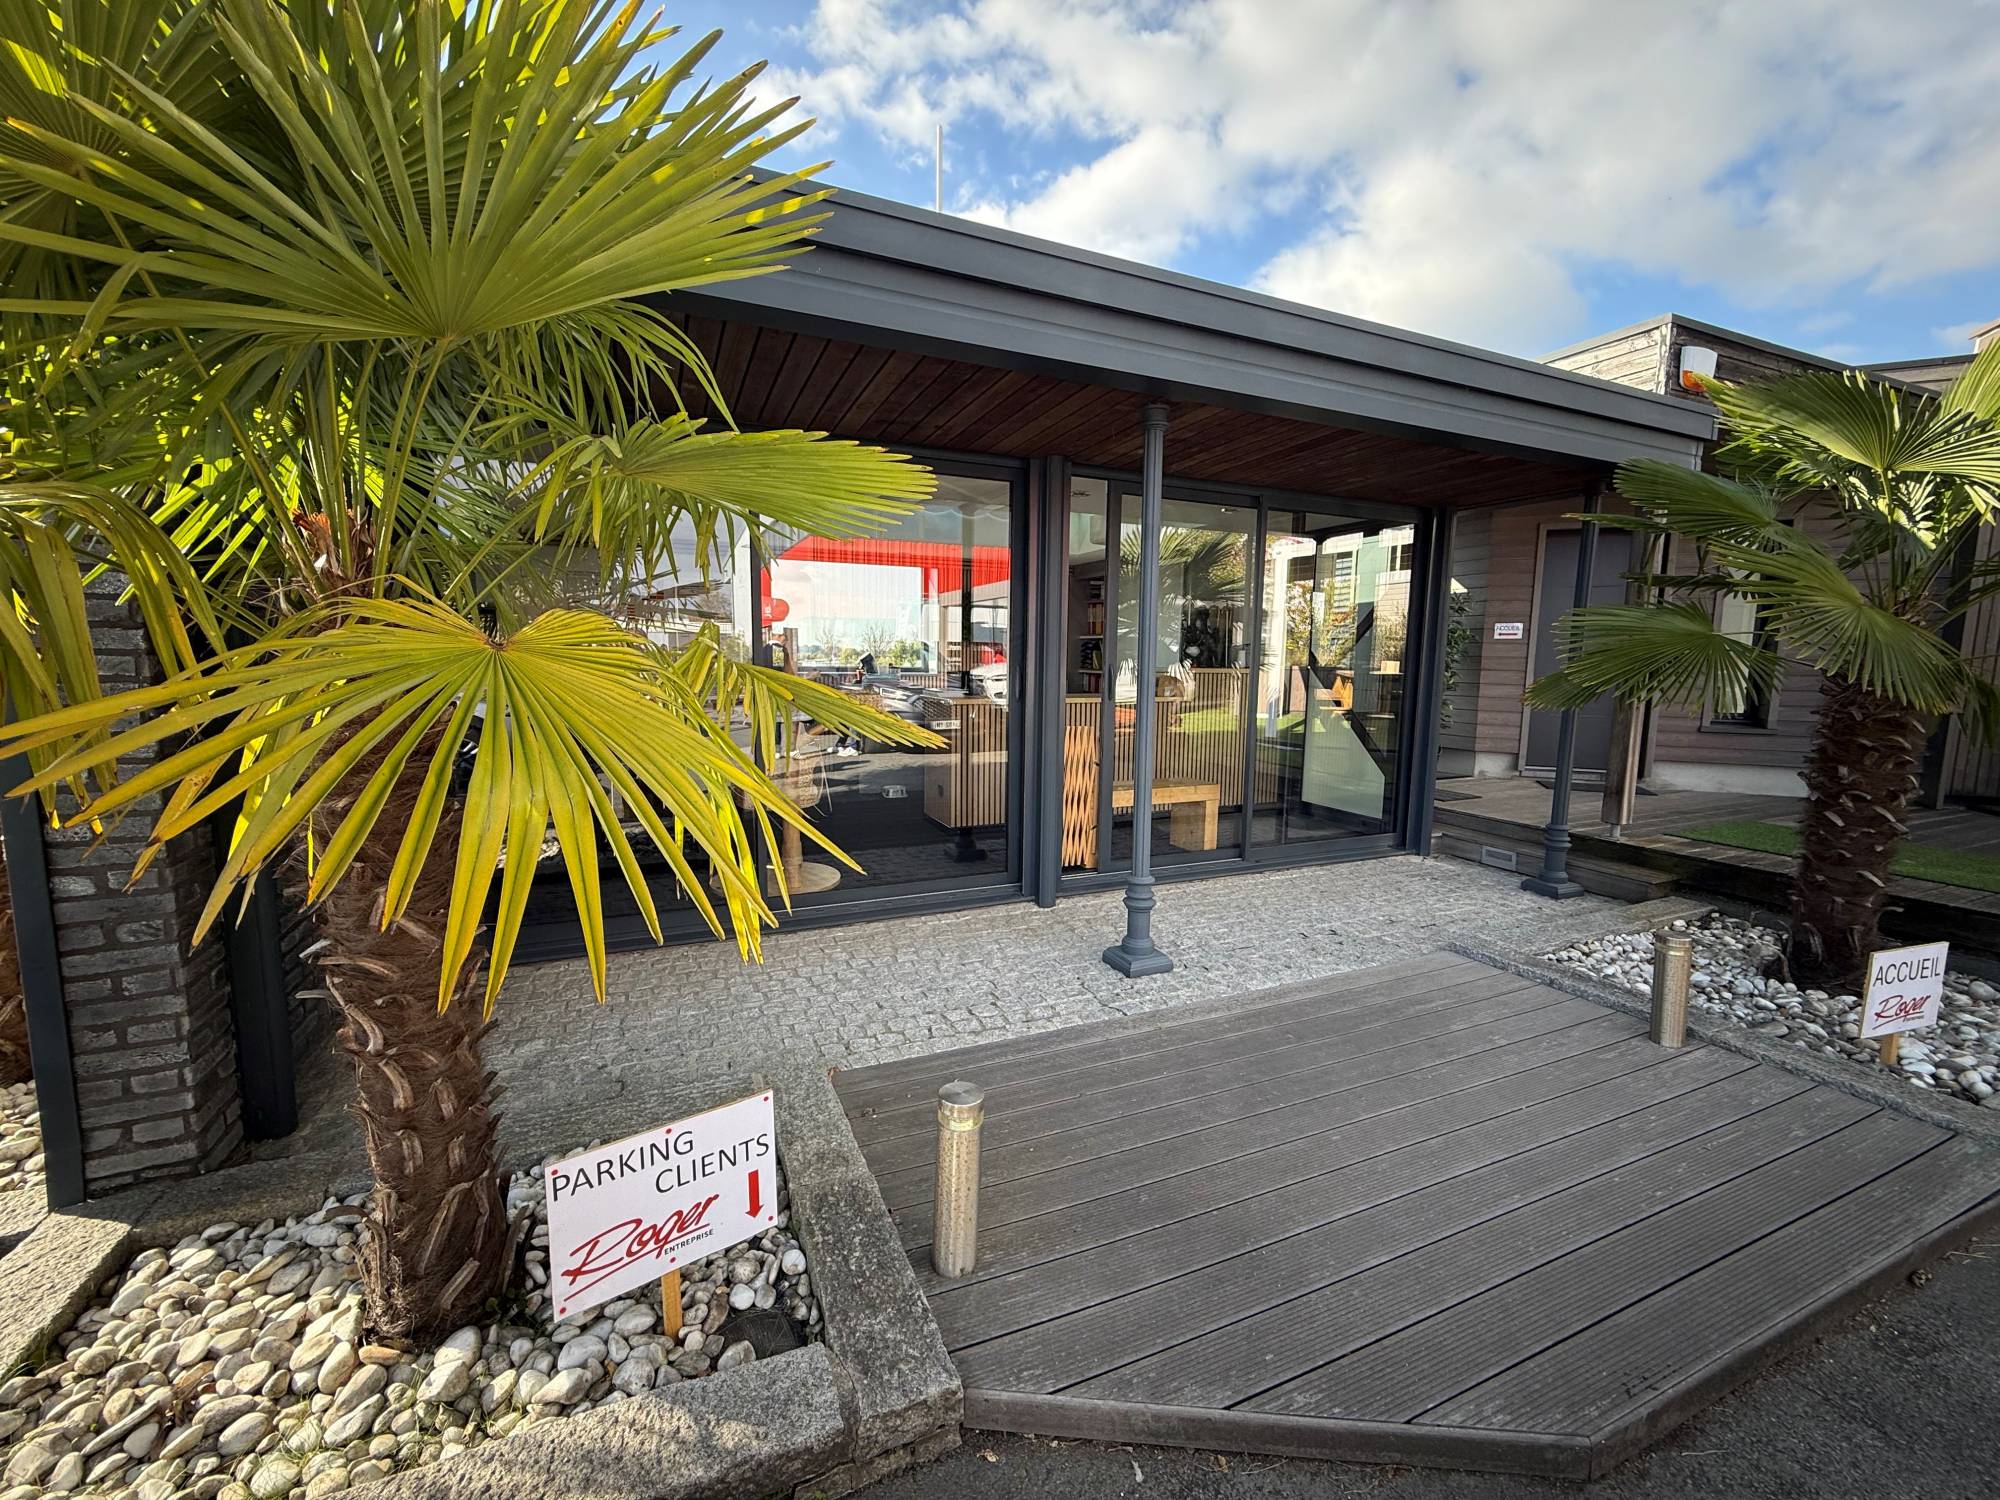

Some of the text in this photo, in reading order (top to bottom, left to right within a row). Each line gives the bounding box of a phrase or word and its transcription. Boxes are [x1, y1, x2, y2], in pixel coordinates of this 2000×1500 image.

[1872, 957, 1941, 987] ACCUEIL
[1874, 994, 1932, 1021] Roger
[551, 1130, 694, 1202] PARKING
[655, 1133, 770, 1194] CLIENTS
[561, 1194, 719, 1286] Roger
[664, 1228, 714, 1255] ENTREPRISE
